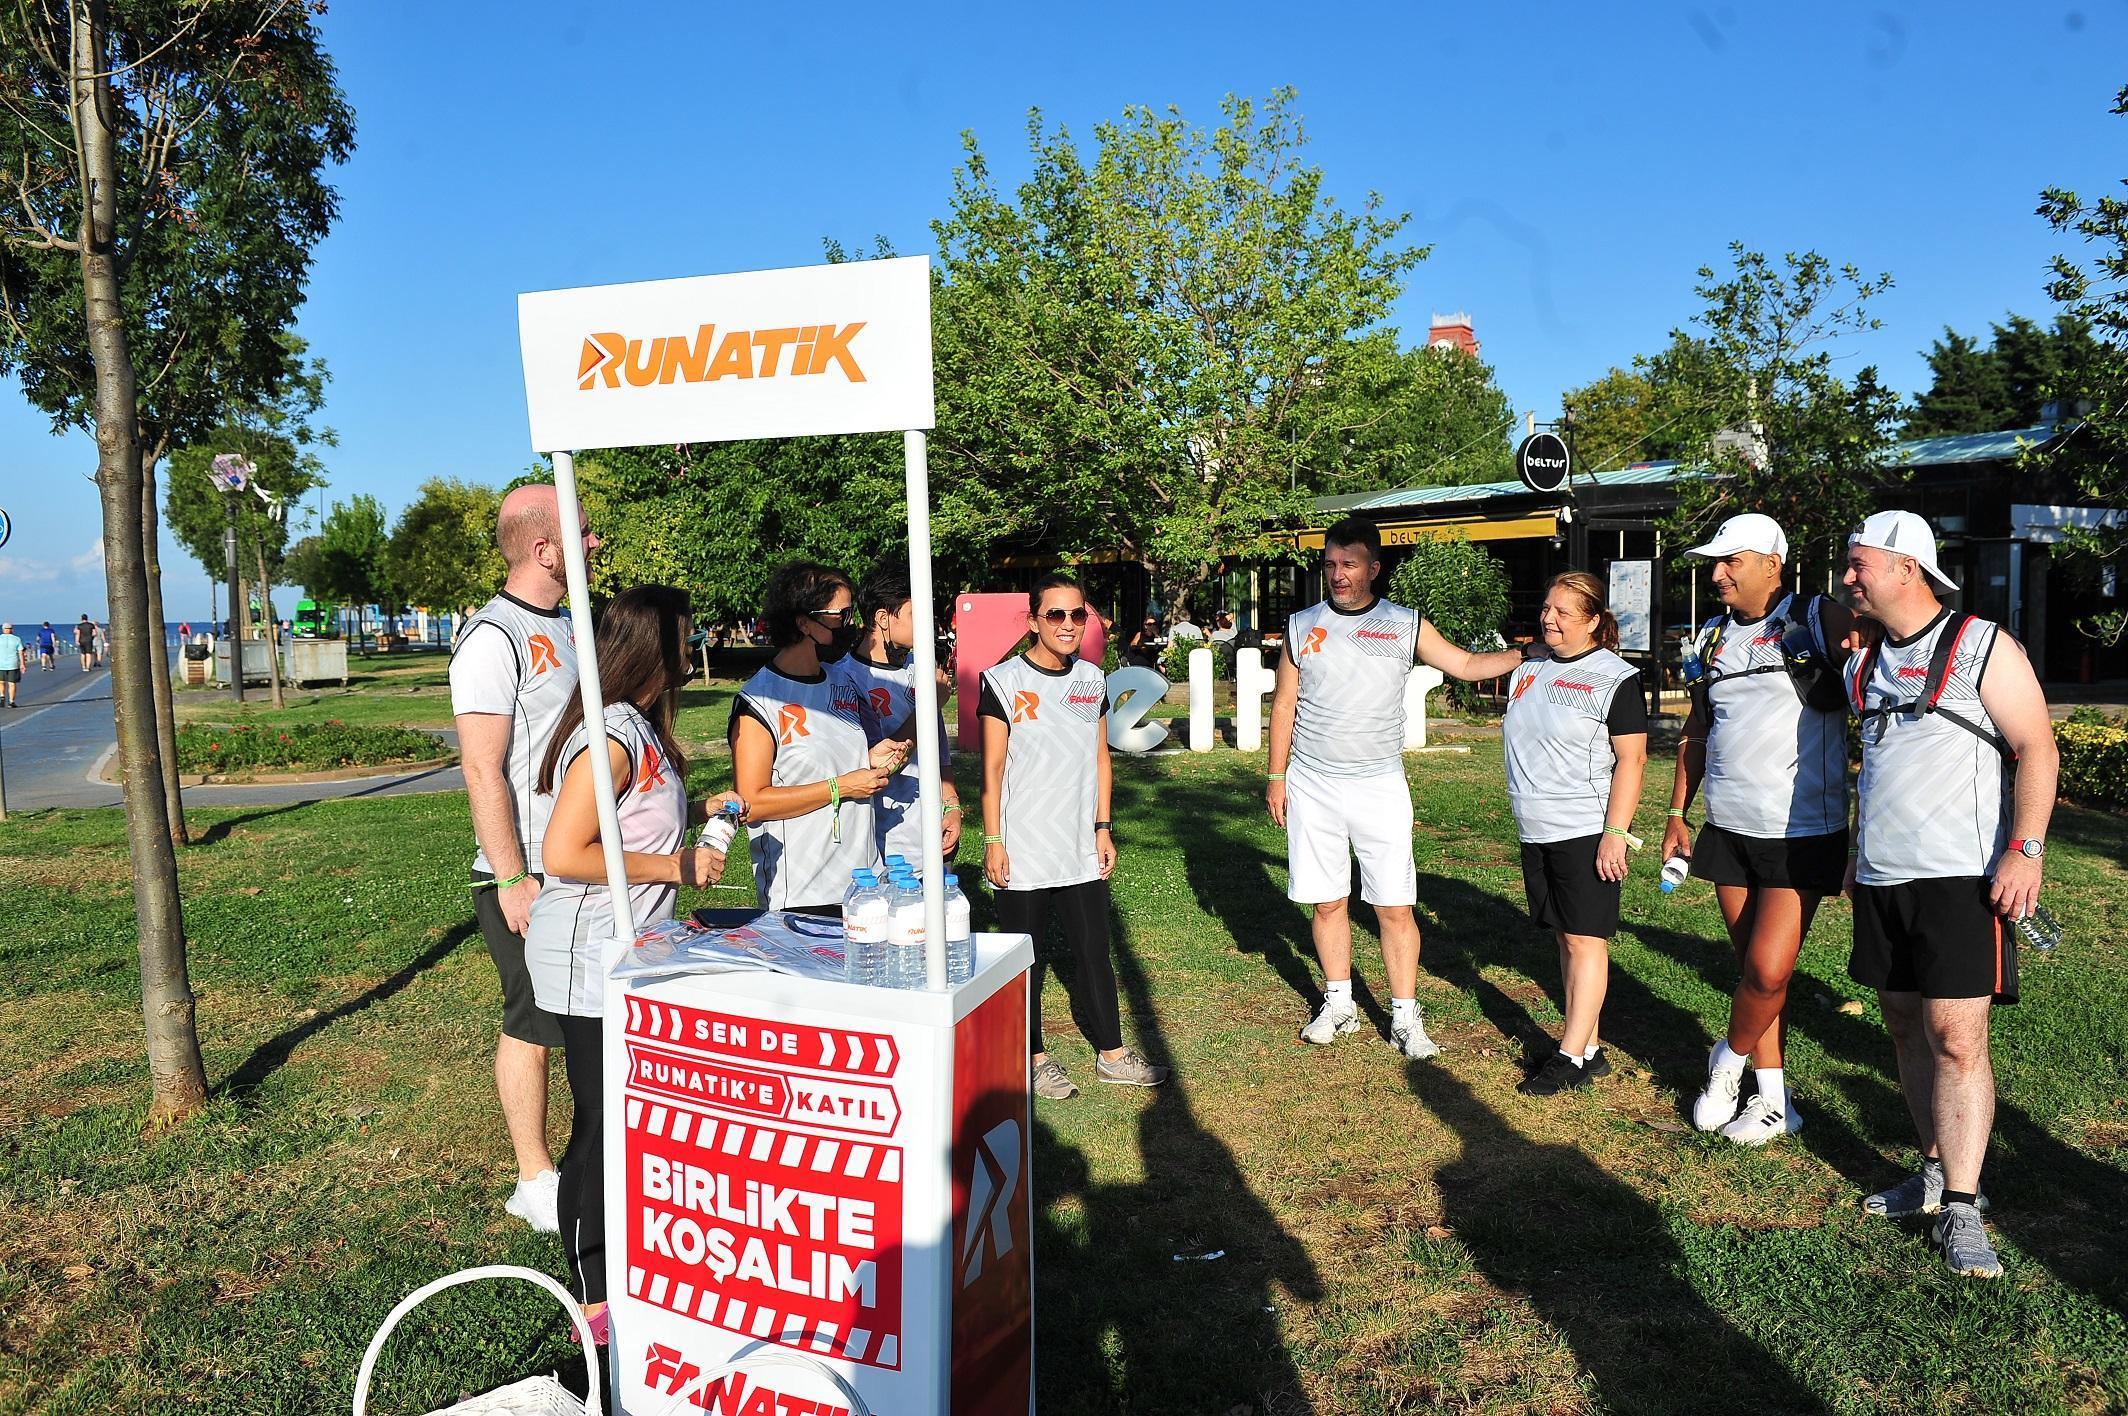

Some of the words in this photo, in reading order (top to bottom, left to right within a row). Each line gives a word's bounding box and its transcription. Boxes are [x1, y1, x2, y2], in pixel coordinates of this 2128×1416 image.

[694, 1019, 748, 1048] SEN
[760, 1029, 798, 1055] DE
[797, 1092, 886, 1121] KATIL
[643, 1206, 877, 1309] KOŞALIM
